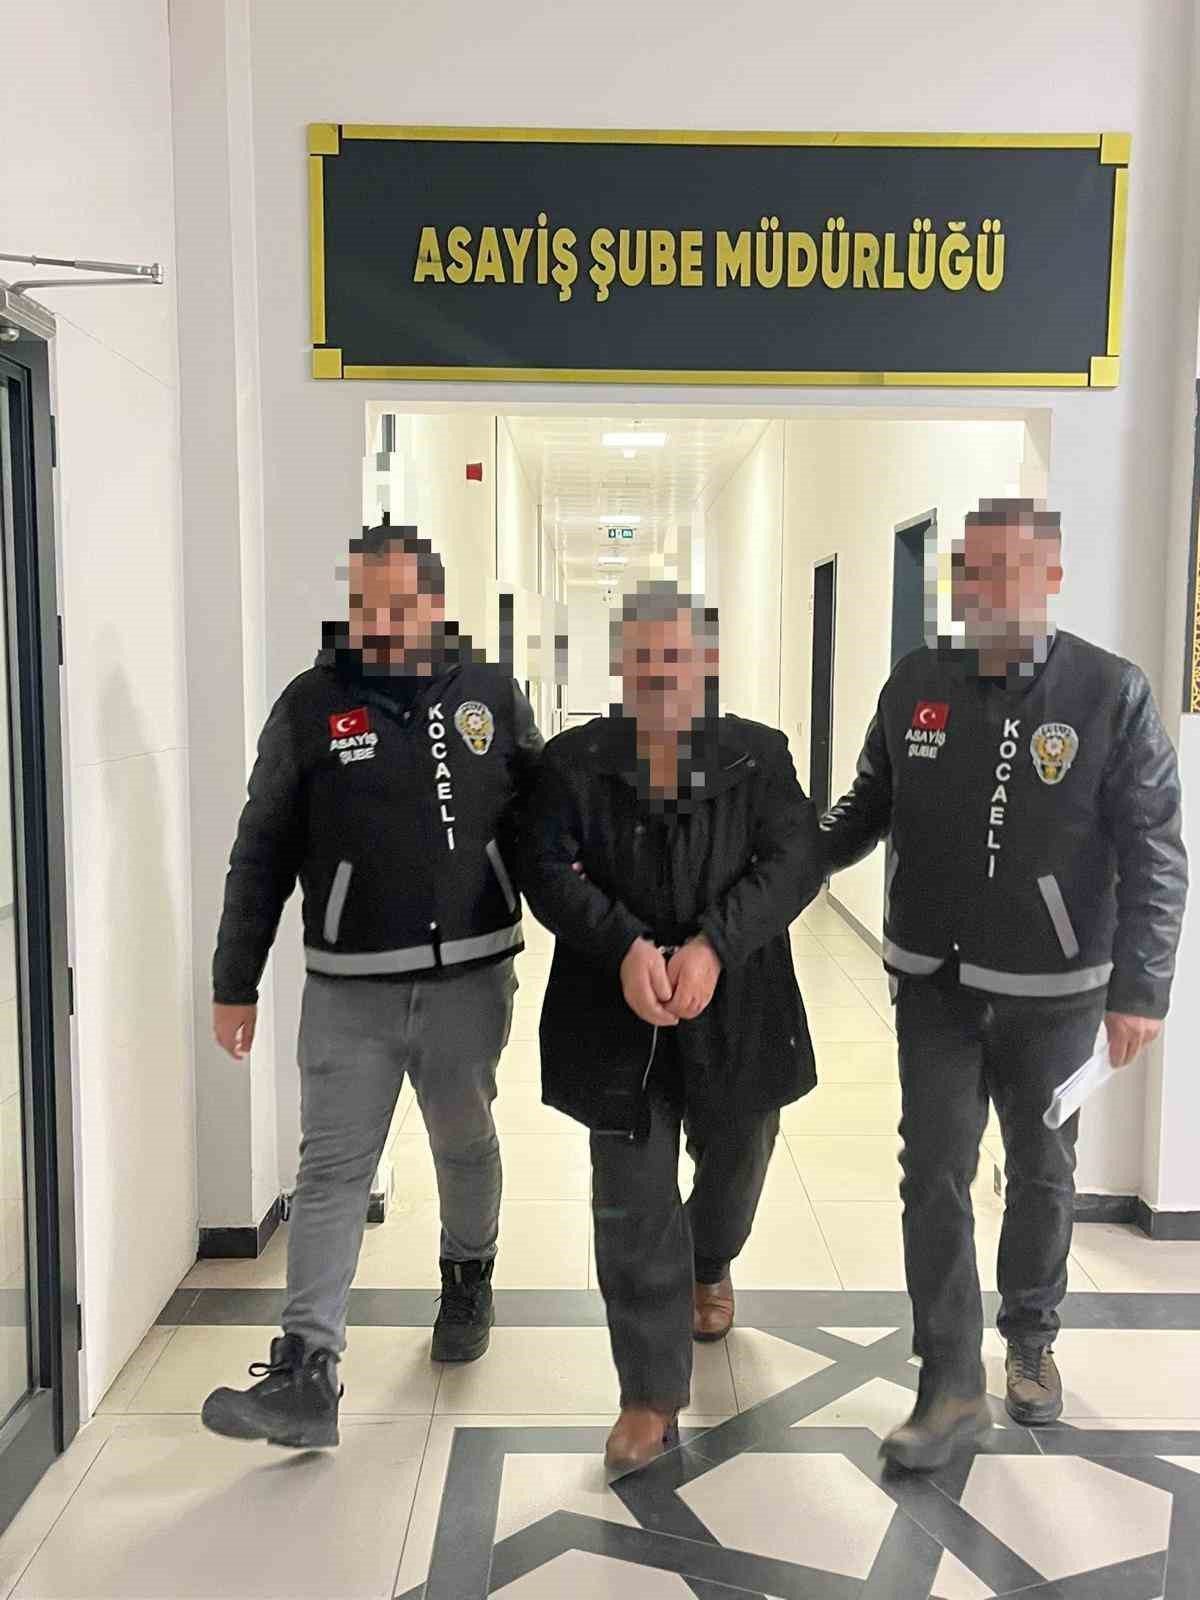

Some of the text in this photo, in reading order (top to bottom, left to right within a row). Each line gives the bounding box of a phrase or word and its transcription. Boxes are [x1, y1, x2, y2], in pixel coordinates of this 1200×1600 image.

[414, 213, 1006, 302] ASAYİŞ ŞUBE MÜDÜRLÜĞÜ
